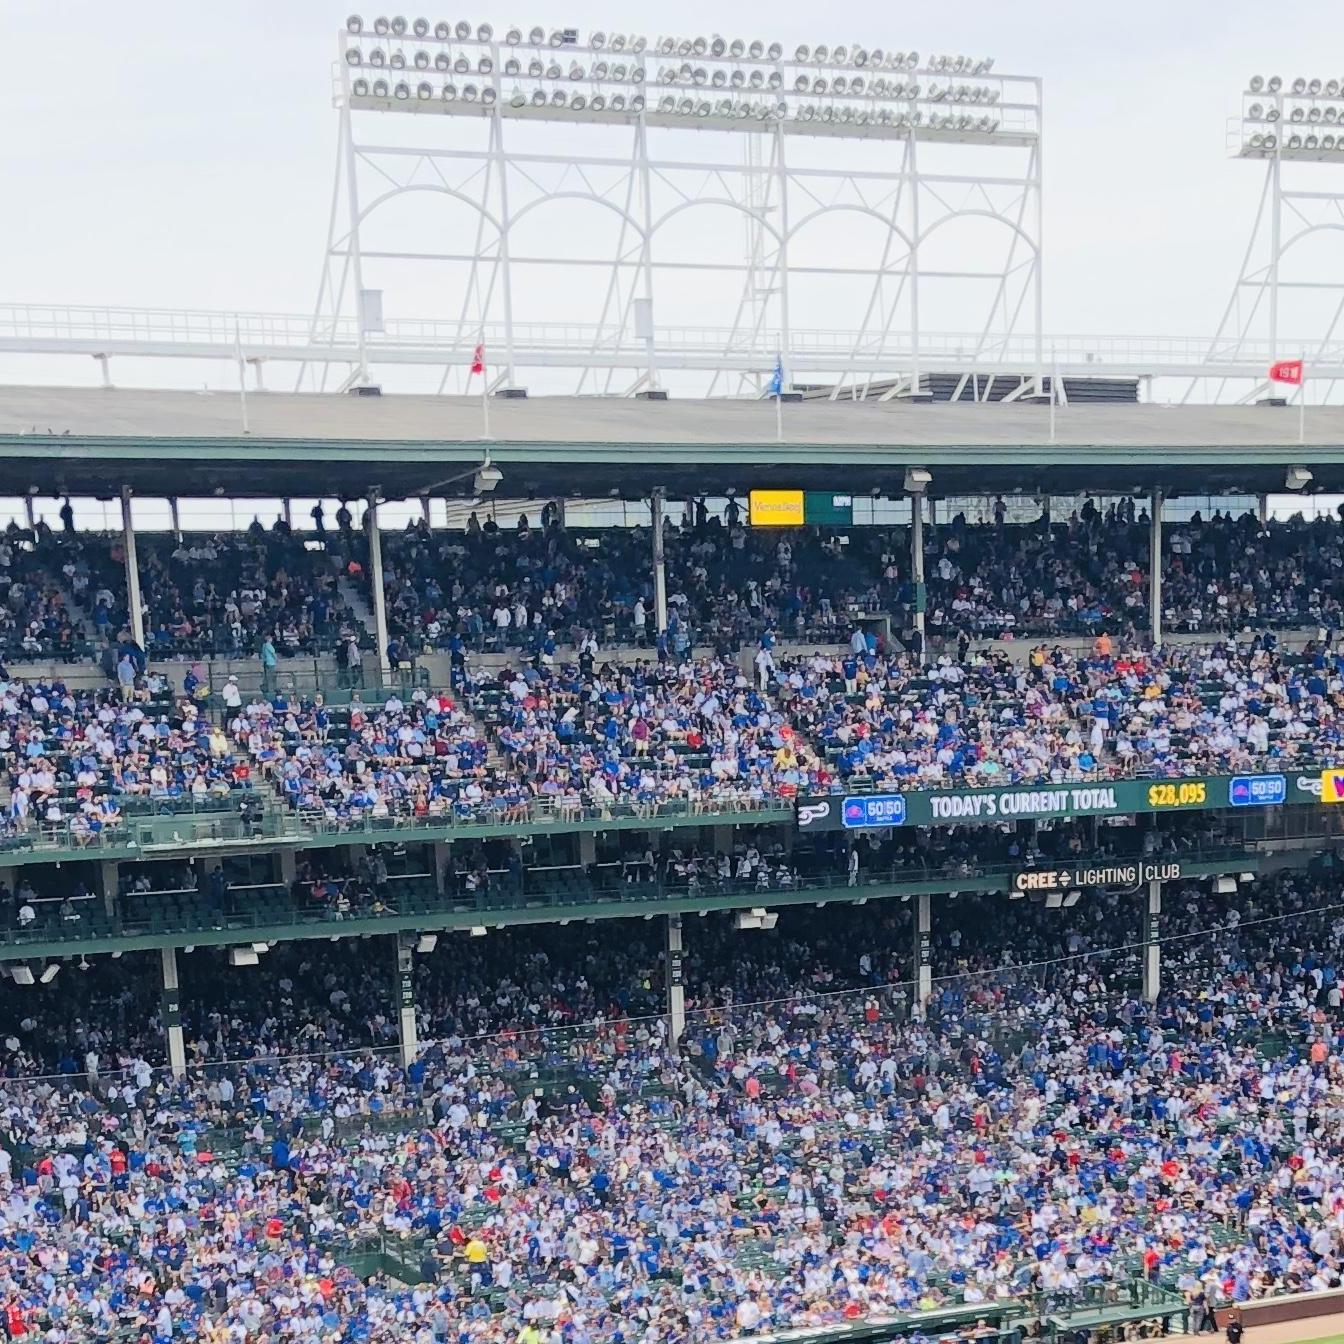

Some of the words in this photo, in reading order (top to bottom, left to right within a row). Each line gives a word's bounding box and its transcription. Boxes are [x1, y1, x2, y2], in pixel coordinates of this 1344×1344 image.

[930, 794, 997, 818] TODAY'S
[999, 790, 1069, 815] CURRENT
[1071, 787, 1118, 810] TOTAL
[1148, 782, 1207, 807] $28,095
[1016, 872, 1057, 889] CREE
[1075, 867, 1136, 886] LIGHTING
[1145, 863, 1180, 881] CLUB
